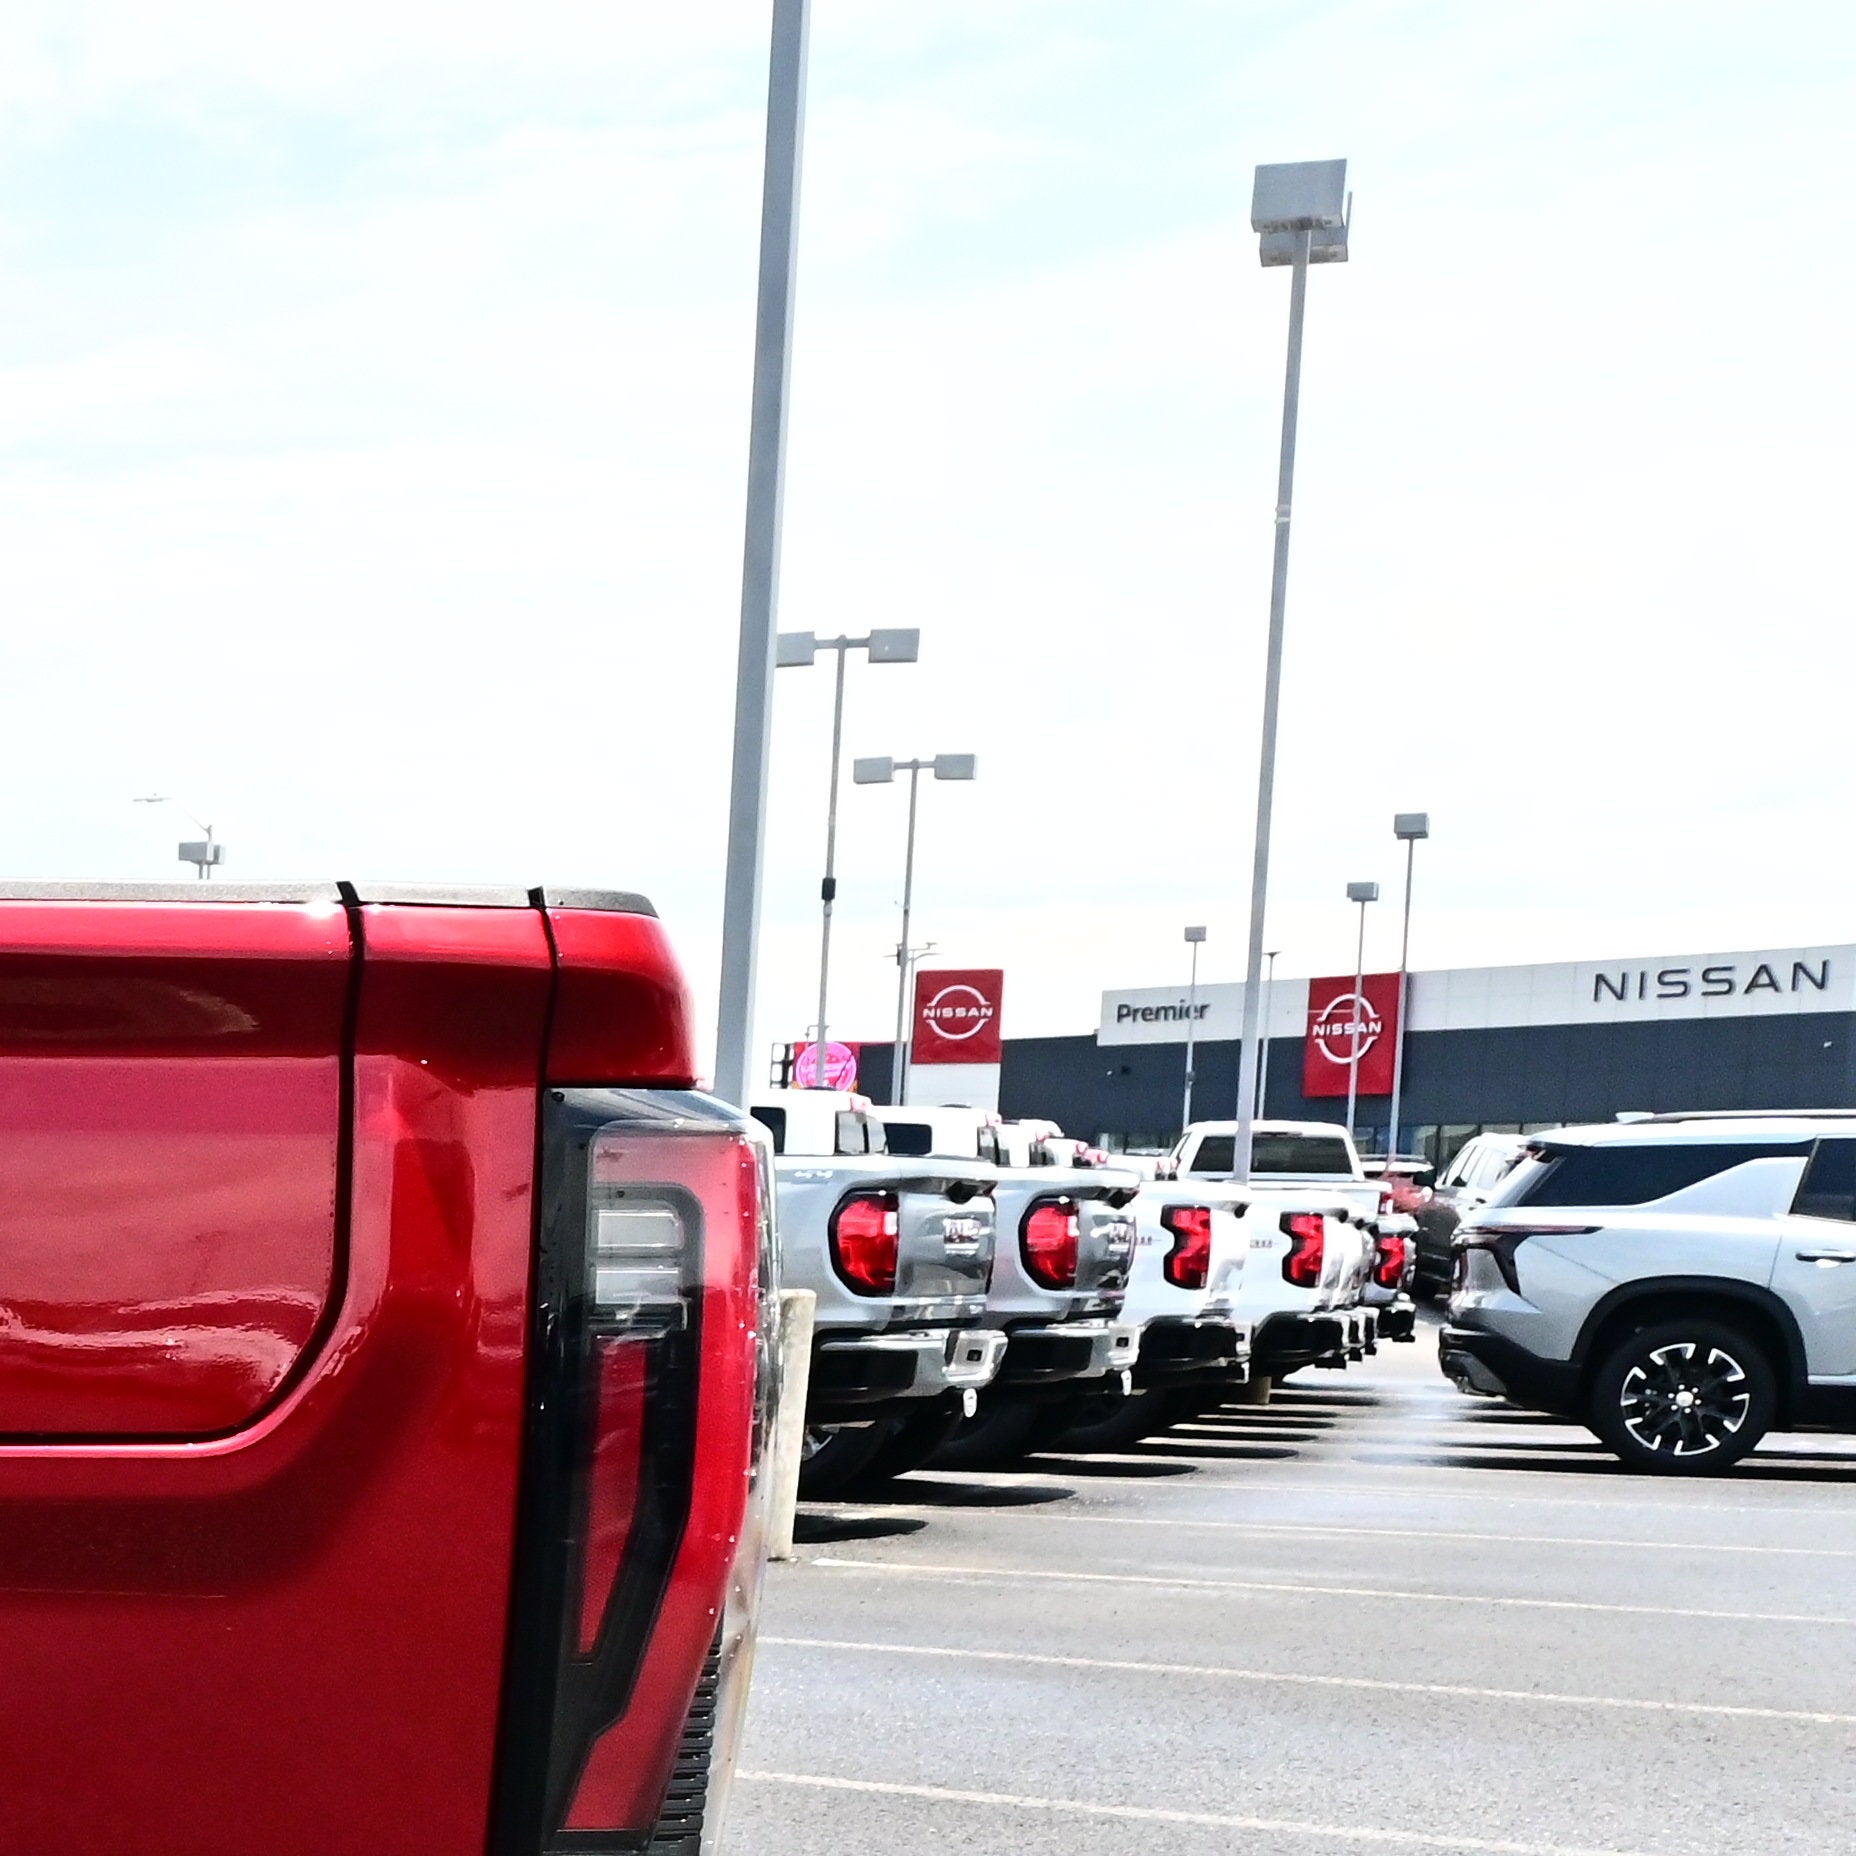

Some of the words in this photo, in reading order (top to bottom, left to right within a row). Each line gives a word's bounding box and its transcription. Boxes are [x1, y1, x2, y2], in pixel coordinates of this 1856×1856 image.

[1592, 959, 1830, 1002] NISSAN
[922, 1006, 994, 1018] NISSAN
[1117, 998, 1211, 1023] Premier
[1312, 1021, 1382, 1036] NISSAN
